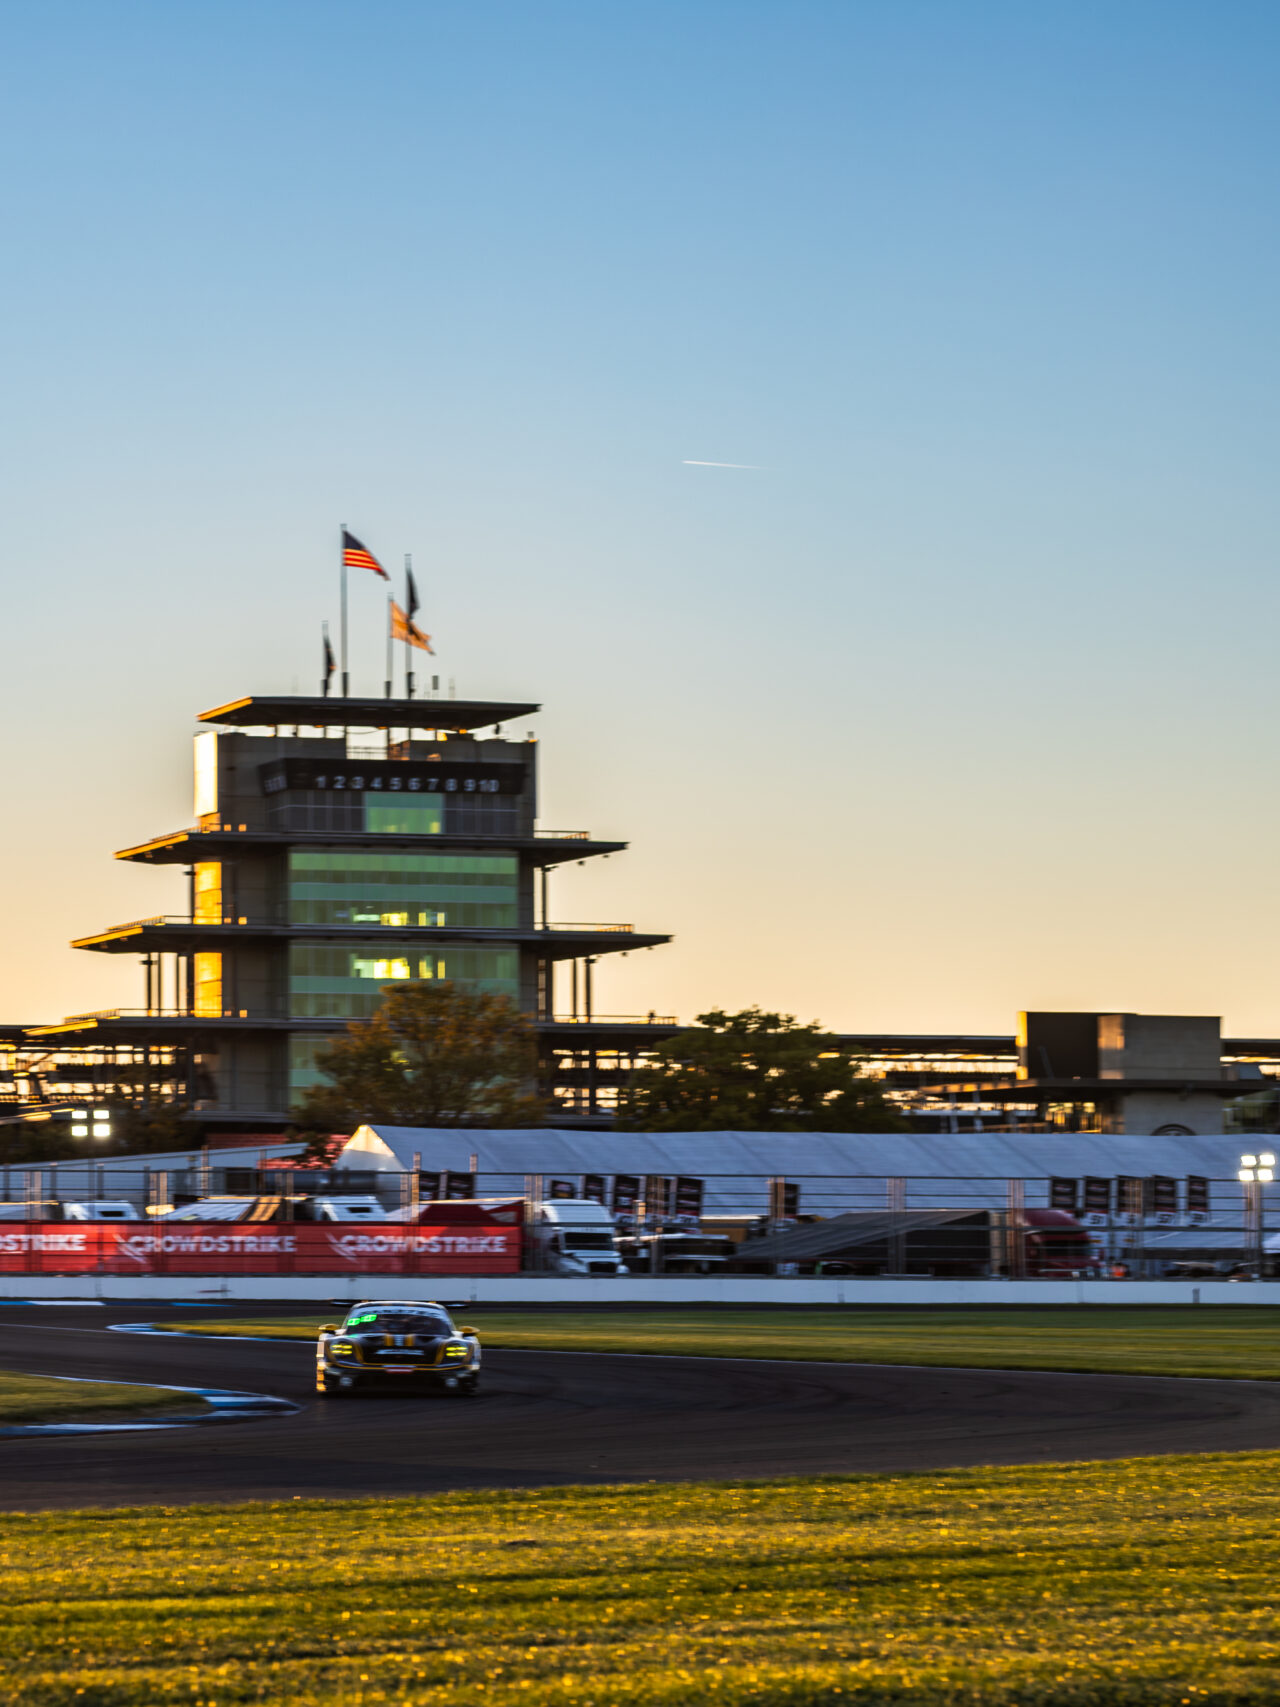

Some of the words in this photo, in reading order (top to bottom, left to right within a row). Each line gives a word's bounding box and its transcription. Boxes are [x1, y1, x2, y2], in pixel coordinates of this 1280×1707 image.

[333, 776, 346, 788] 2
[351, 776, 365, 789] 3
[370, 776, 383, 789] 4
[389, 777, 402, 790] 5
[408, 777, 421, 790] 6
[426, 778, 440, 790] 7
[445, 778, 458, 791] 8
[463, 779, 477, 791] 9
[479, 779, 500, 792] 10
[126, 1235, 297, 1253] CROWDSTRIKE
[340, 1235, 508, 1253] CROWDSTRIKE
